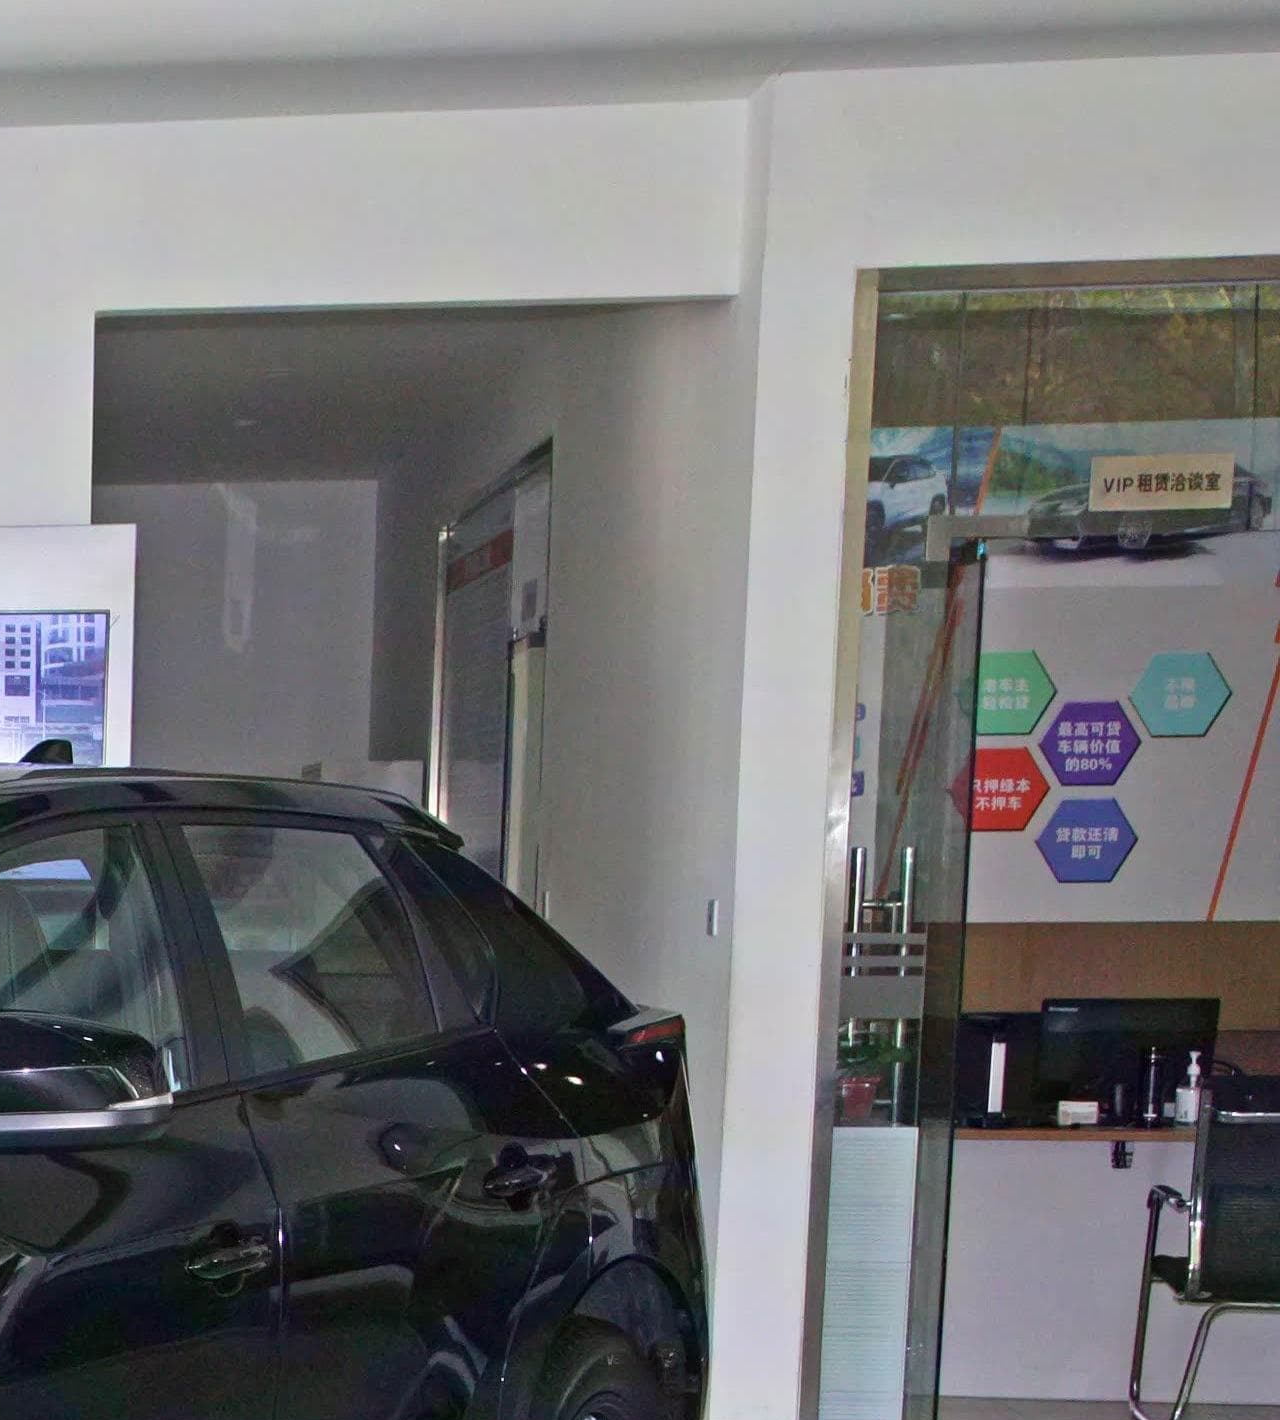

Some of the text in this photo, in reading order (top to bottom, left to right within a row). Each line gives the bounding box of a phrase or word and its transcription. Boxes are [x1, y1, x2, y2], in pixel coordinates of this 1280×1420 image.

[1103, 477, 1134, 493] VIP
[1057, 739, 1121, 755] 车辆价值
[1065, 757, 1112, 772] 的80%
[975, 797, 1023, 811] 不押车
[1071, 844, 1103, 859] 即可
